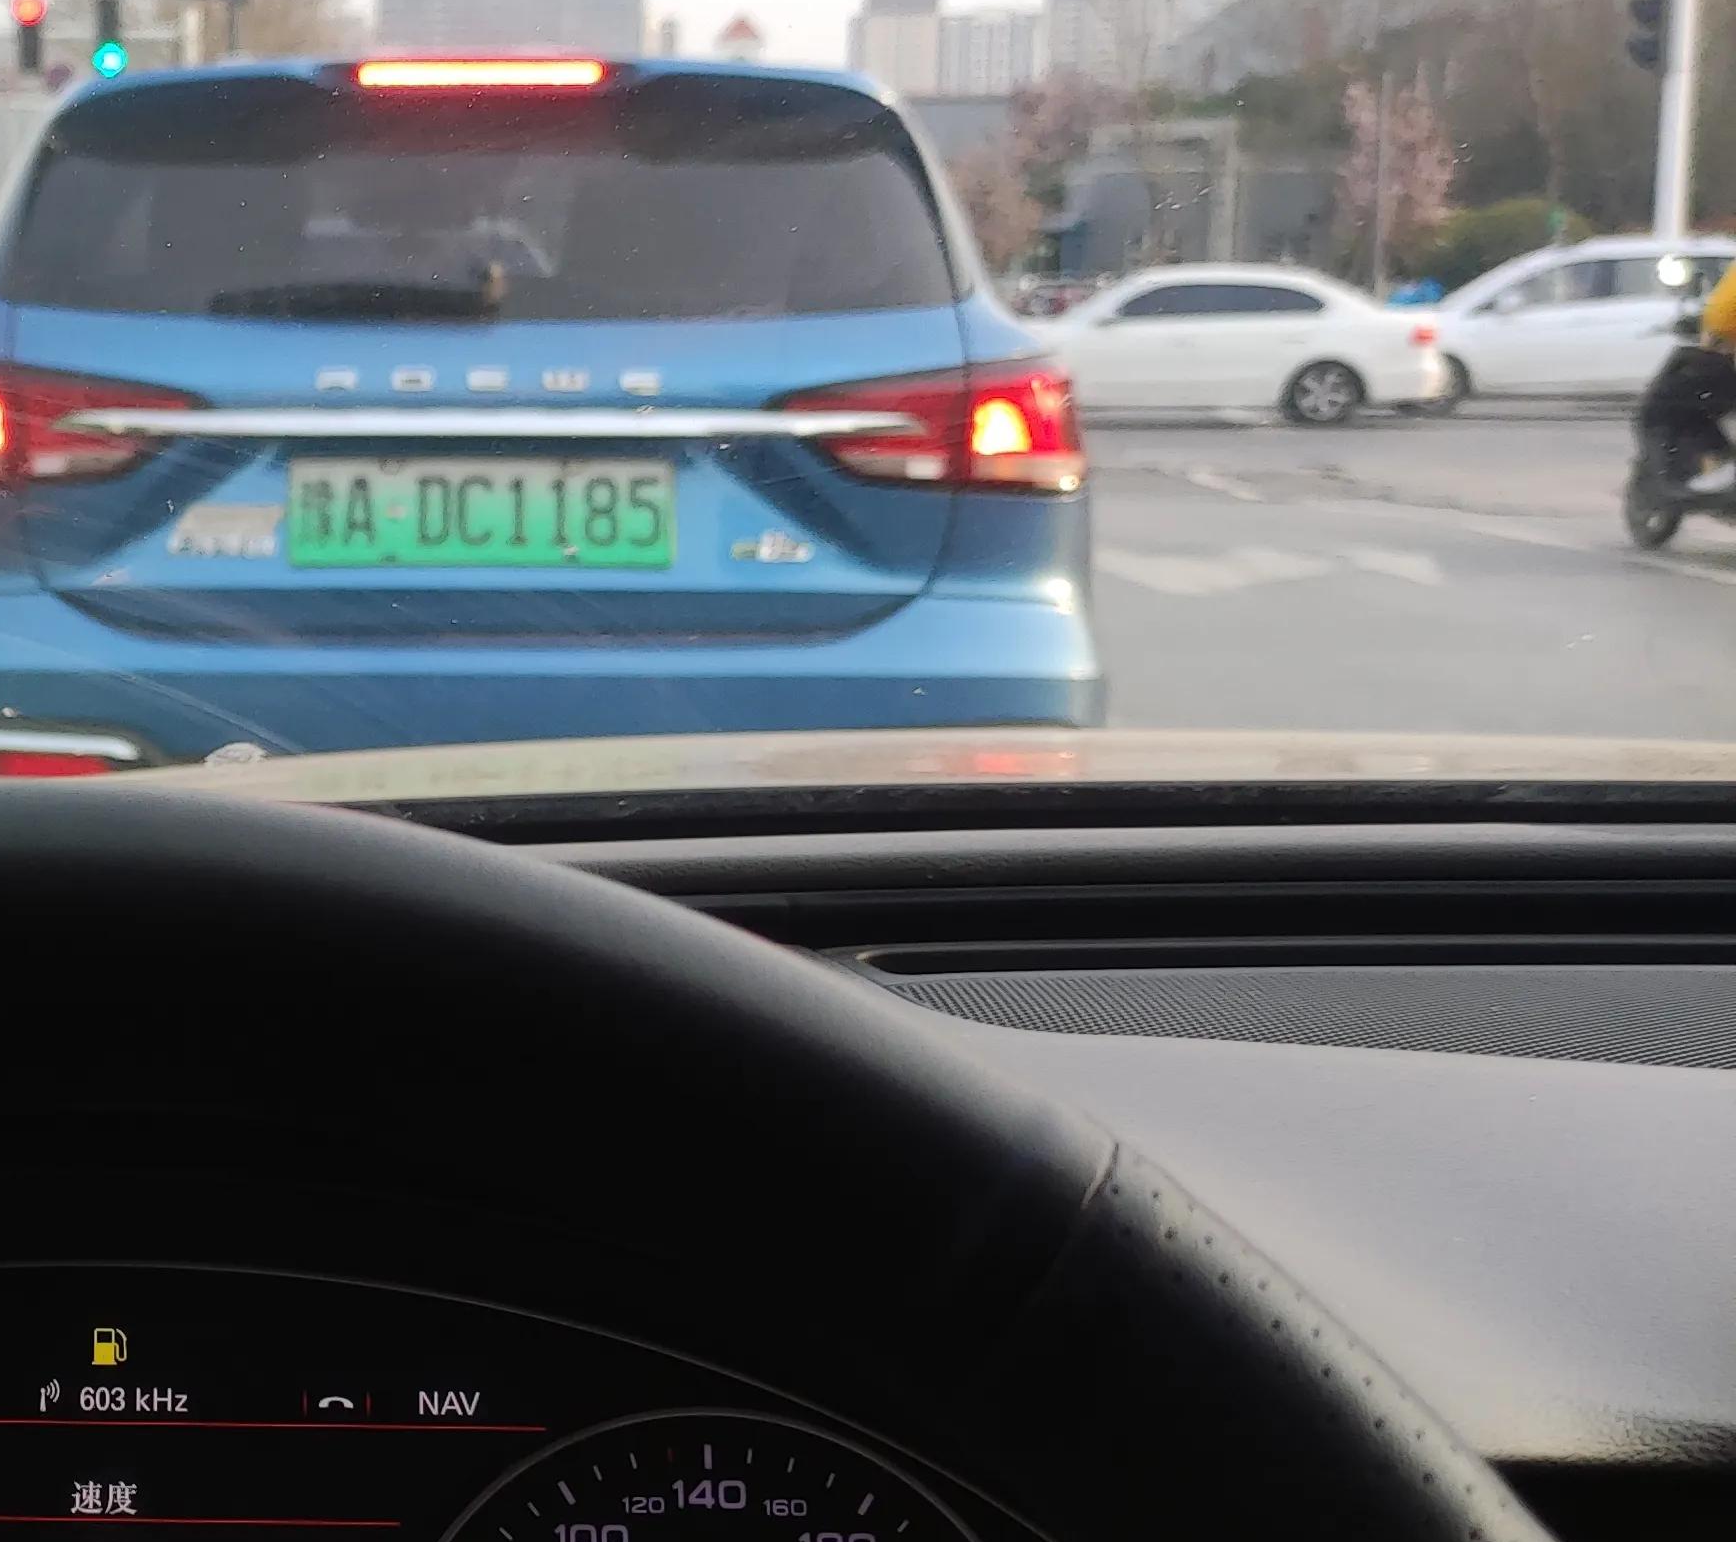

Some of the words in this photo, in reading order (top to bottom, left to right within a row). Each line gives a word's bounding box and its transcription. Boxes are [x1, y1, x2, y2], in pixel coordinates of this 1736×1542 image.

[80, 1387, 125, 1411] 603
[136, 1388, 187, 1412] kHz
[419, 1391, 480, 1415] NAV
[71, 1481, 138, 1516] 速度
[622, 1497, 664, 1513] 120
[672, 1480, 746, 1509] 140
[764, 1499, 806, 1516] 160
